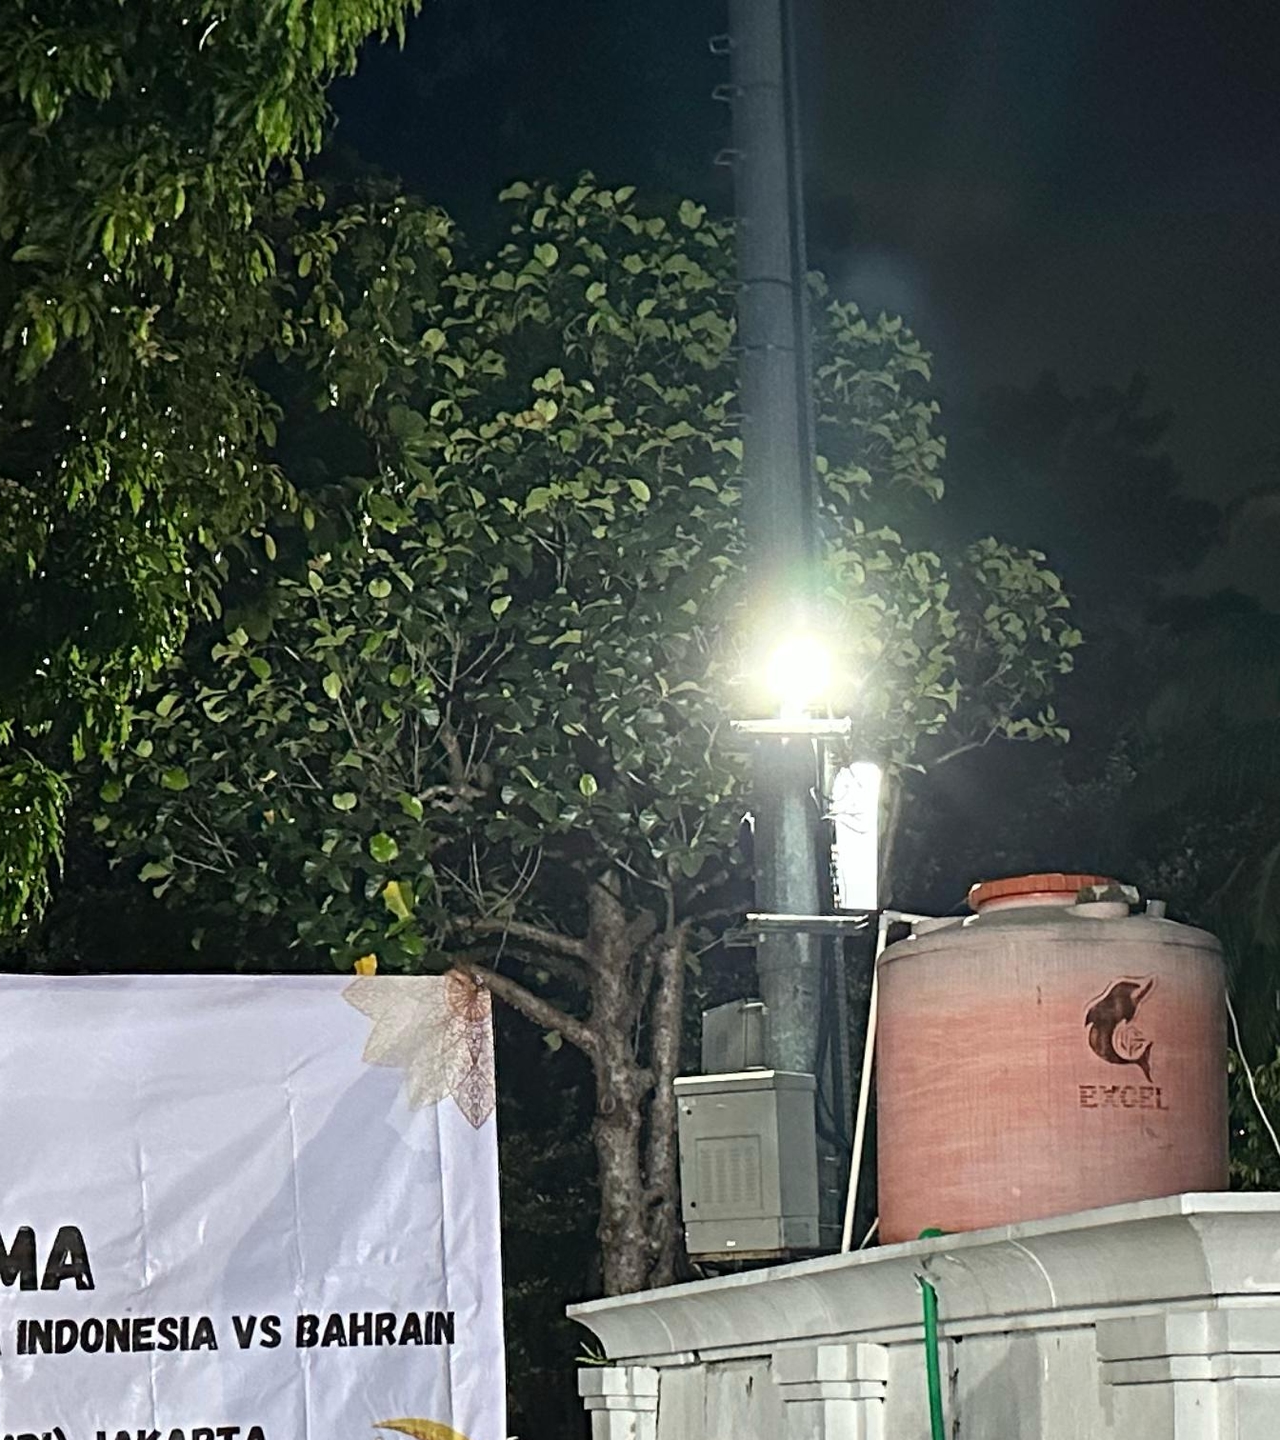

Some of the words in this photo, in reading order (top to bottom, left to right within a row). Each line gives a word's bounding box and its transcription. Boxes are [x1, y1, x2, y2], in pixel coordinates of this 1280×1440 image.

[1079, 1085, 1170, 1111] EXCEL
[17, 1317, 218, 1355] INDONESIA
[232, 1315, 281, 1349] VS
[296, 1312, 454, 1348] BAHRAIN
